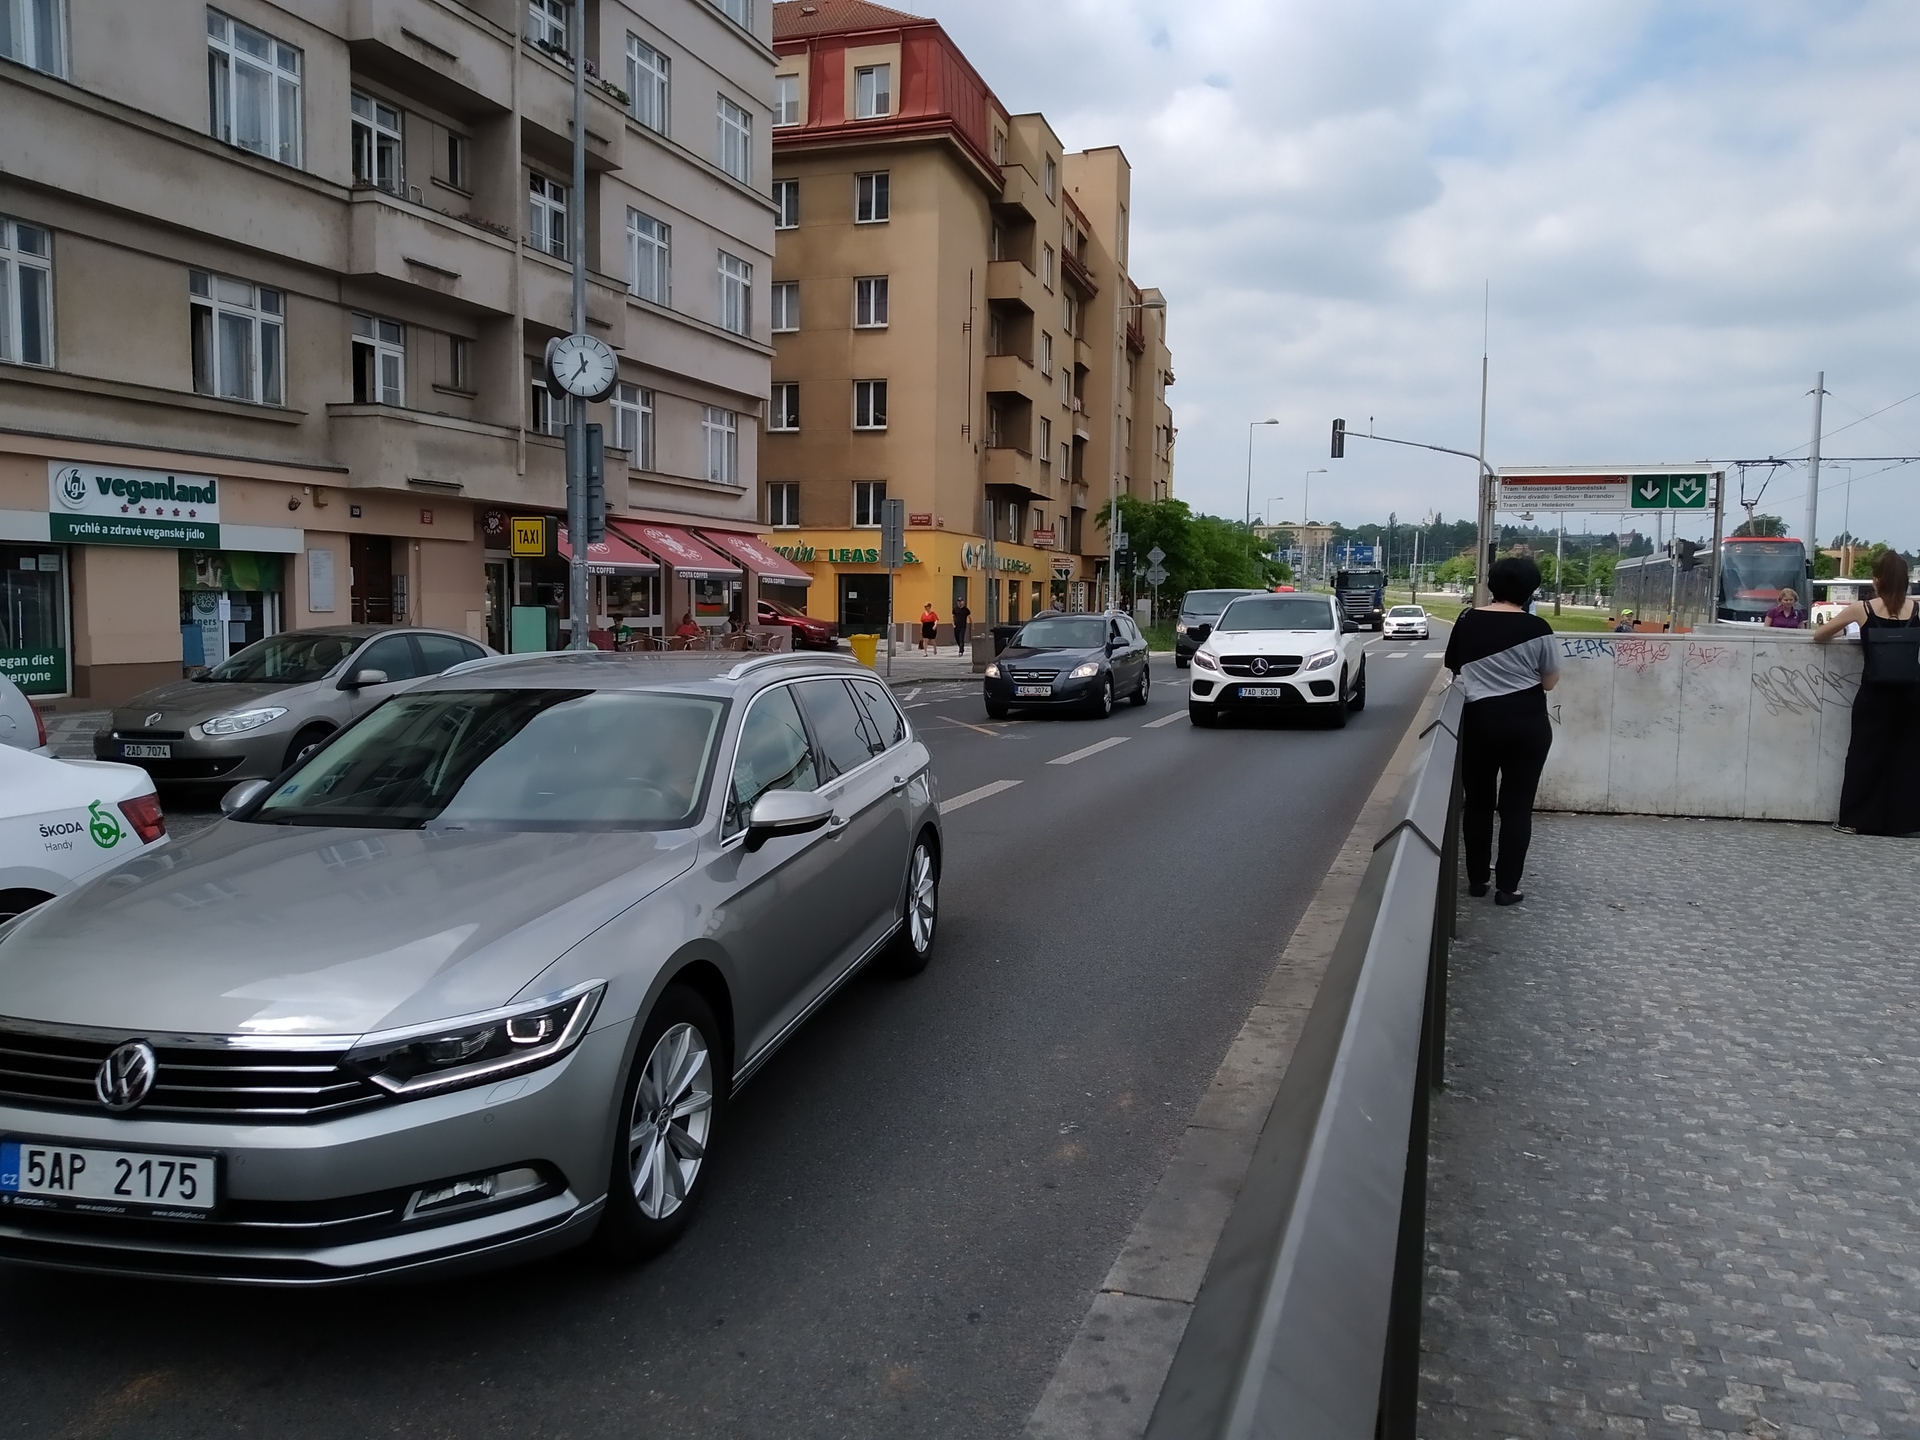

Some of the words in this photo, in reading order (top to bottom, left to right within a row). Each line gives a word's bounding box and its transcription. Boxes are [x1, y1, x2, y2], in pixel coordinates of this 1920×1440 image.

[95, 476, 217, 505] veganland
[69, 522, 100, 536] rychlé
[102, 525, 108, 534] a
[110, 524, 142, 536] zdravé
[143, 527, 185, 540] veganské
[186, 528, 205, 541] jídlo
[517, 529, 539, 545] TAXI
[197, 592, 216, 600] GRAB
[0, 656, 28, 669] egan
[31, 654, 55, 666] diet
[6, 672, 51, 684] veryone
[1243, 688, 1257, 696] 7AD
[1260, 688, 1278, 696] 6230
[126, 745, 142, 756] 2AD
[147, 746, 167, 757] 7074
[39, 821, 84, 838] ŠKODA
[44, 840, 73, 852] Handy
[1, 1173, 19, 1185] CZ
[28, 1150, 86, 1190] 5AP
[114, 1158, 197, 1200] 2175
